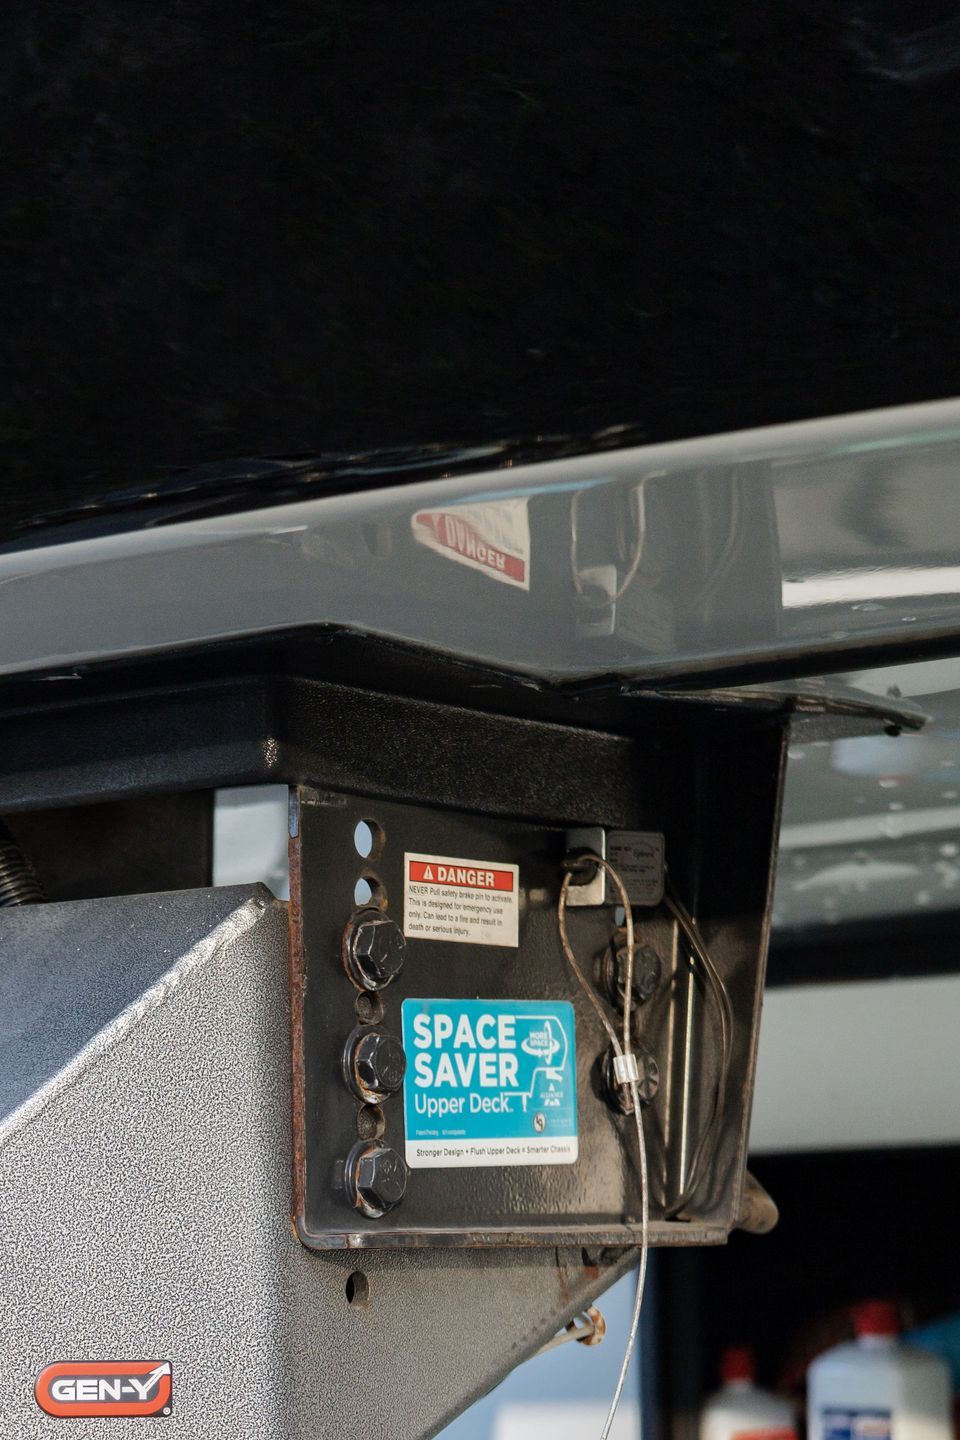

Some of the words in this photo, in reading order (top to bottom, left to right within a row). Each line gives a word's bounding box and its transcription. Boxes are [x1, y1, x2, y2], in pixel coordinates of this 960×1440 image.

[437, 866, 495, 887] DANGER
[408, 885, 428, 895] NEVER
[429, 887, 441, 896] Pull
[441, 888, 457, 899] safety
[459, 890, 474, 900] brake
[475, 892, 484, 902] pin
[485, 893, 491, 901] to
[408, 897, 421, 907] This
[422, 899, 427, 907] is
[428, 899, 453, 910] designed
[454, 902, 462, 910] for
[462, 904, 492, 915] emergency
[408, 910, 422, 920] only.
[423, 912, 434, 920] Can
[435, 913, 447, 921] lead
[448, 914, 454, 922] to
[459, 915, 469, 923] fire
[470, 916, 480, 924] and
[481, 917, 496, 926] result
[408, 922, 424, 931] death
[432, 926, 453, 934] serious
[413, 1013, 517, 1050] SPACE
[414, 1052, 519, 1088] SAVER
[414, 1093, 466, 1118] Upper
[470, 1093, 510, 1114] Deck
[416, 1148, 442, 1158] Stronger
[443, 1147, 464, 1157] Design
[470, 1147, 486, 1156] Flush
[486, 1147, 505, 1156] Upper
[506, 1146, 520, 1154] Deck
[527, 1145, 549, 1153] Smarter
[550, 1144, 571, 1153] Chassis
[51, 1374, 160, 1401] GEN-Y
